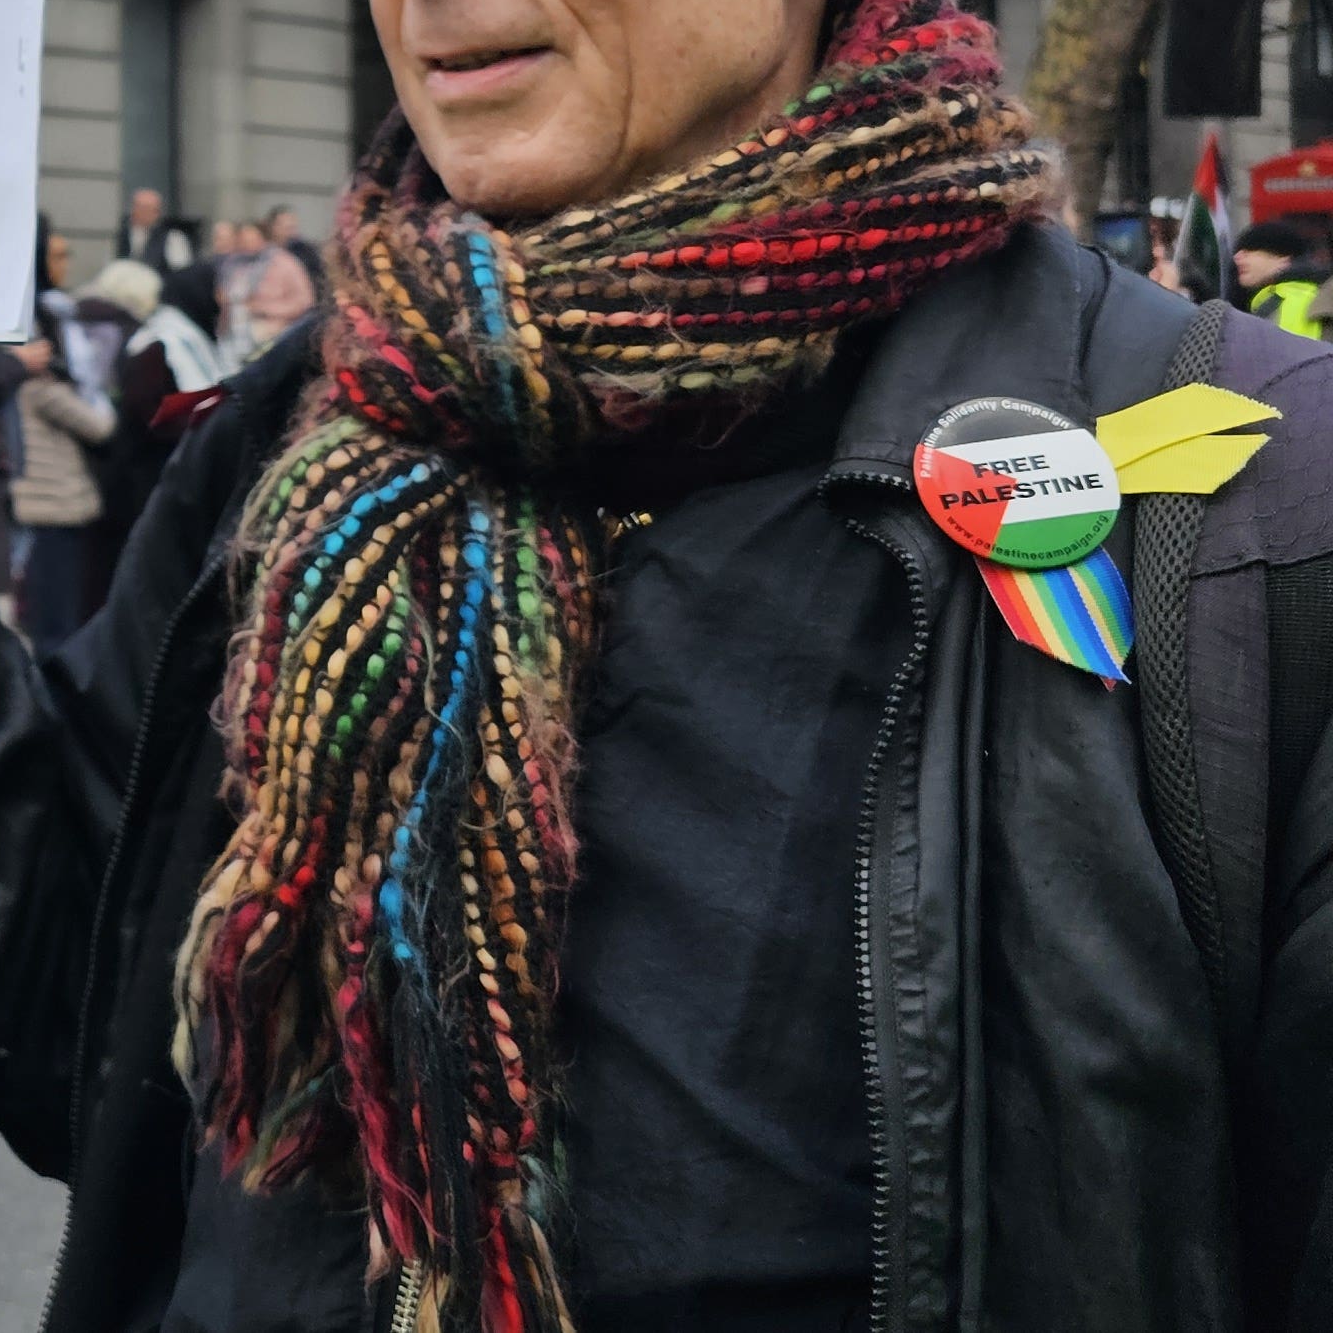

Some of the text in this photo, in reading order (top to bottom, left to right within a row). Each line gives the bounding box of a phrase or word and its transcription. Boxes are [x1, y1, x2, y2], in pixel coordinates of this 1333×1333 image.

[920, 400, 1071, 478] Palestine Solidarity Campaign
[973, 454, 1050, 478] FREE
[938, 473, 1103, 510] PALESTINE
[947, 515, 1109, 560] www.palestinecampaign.org
